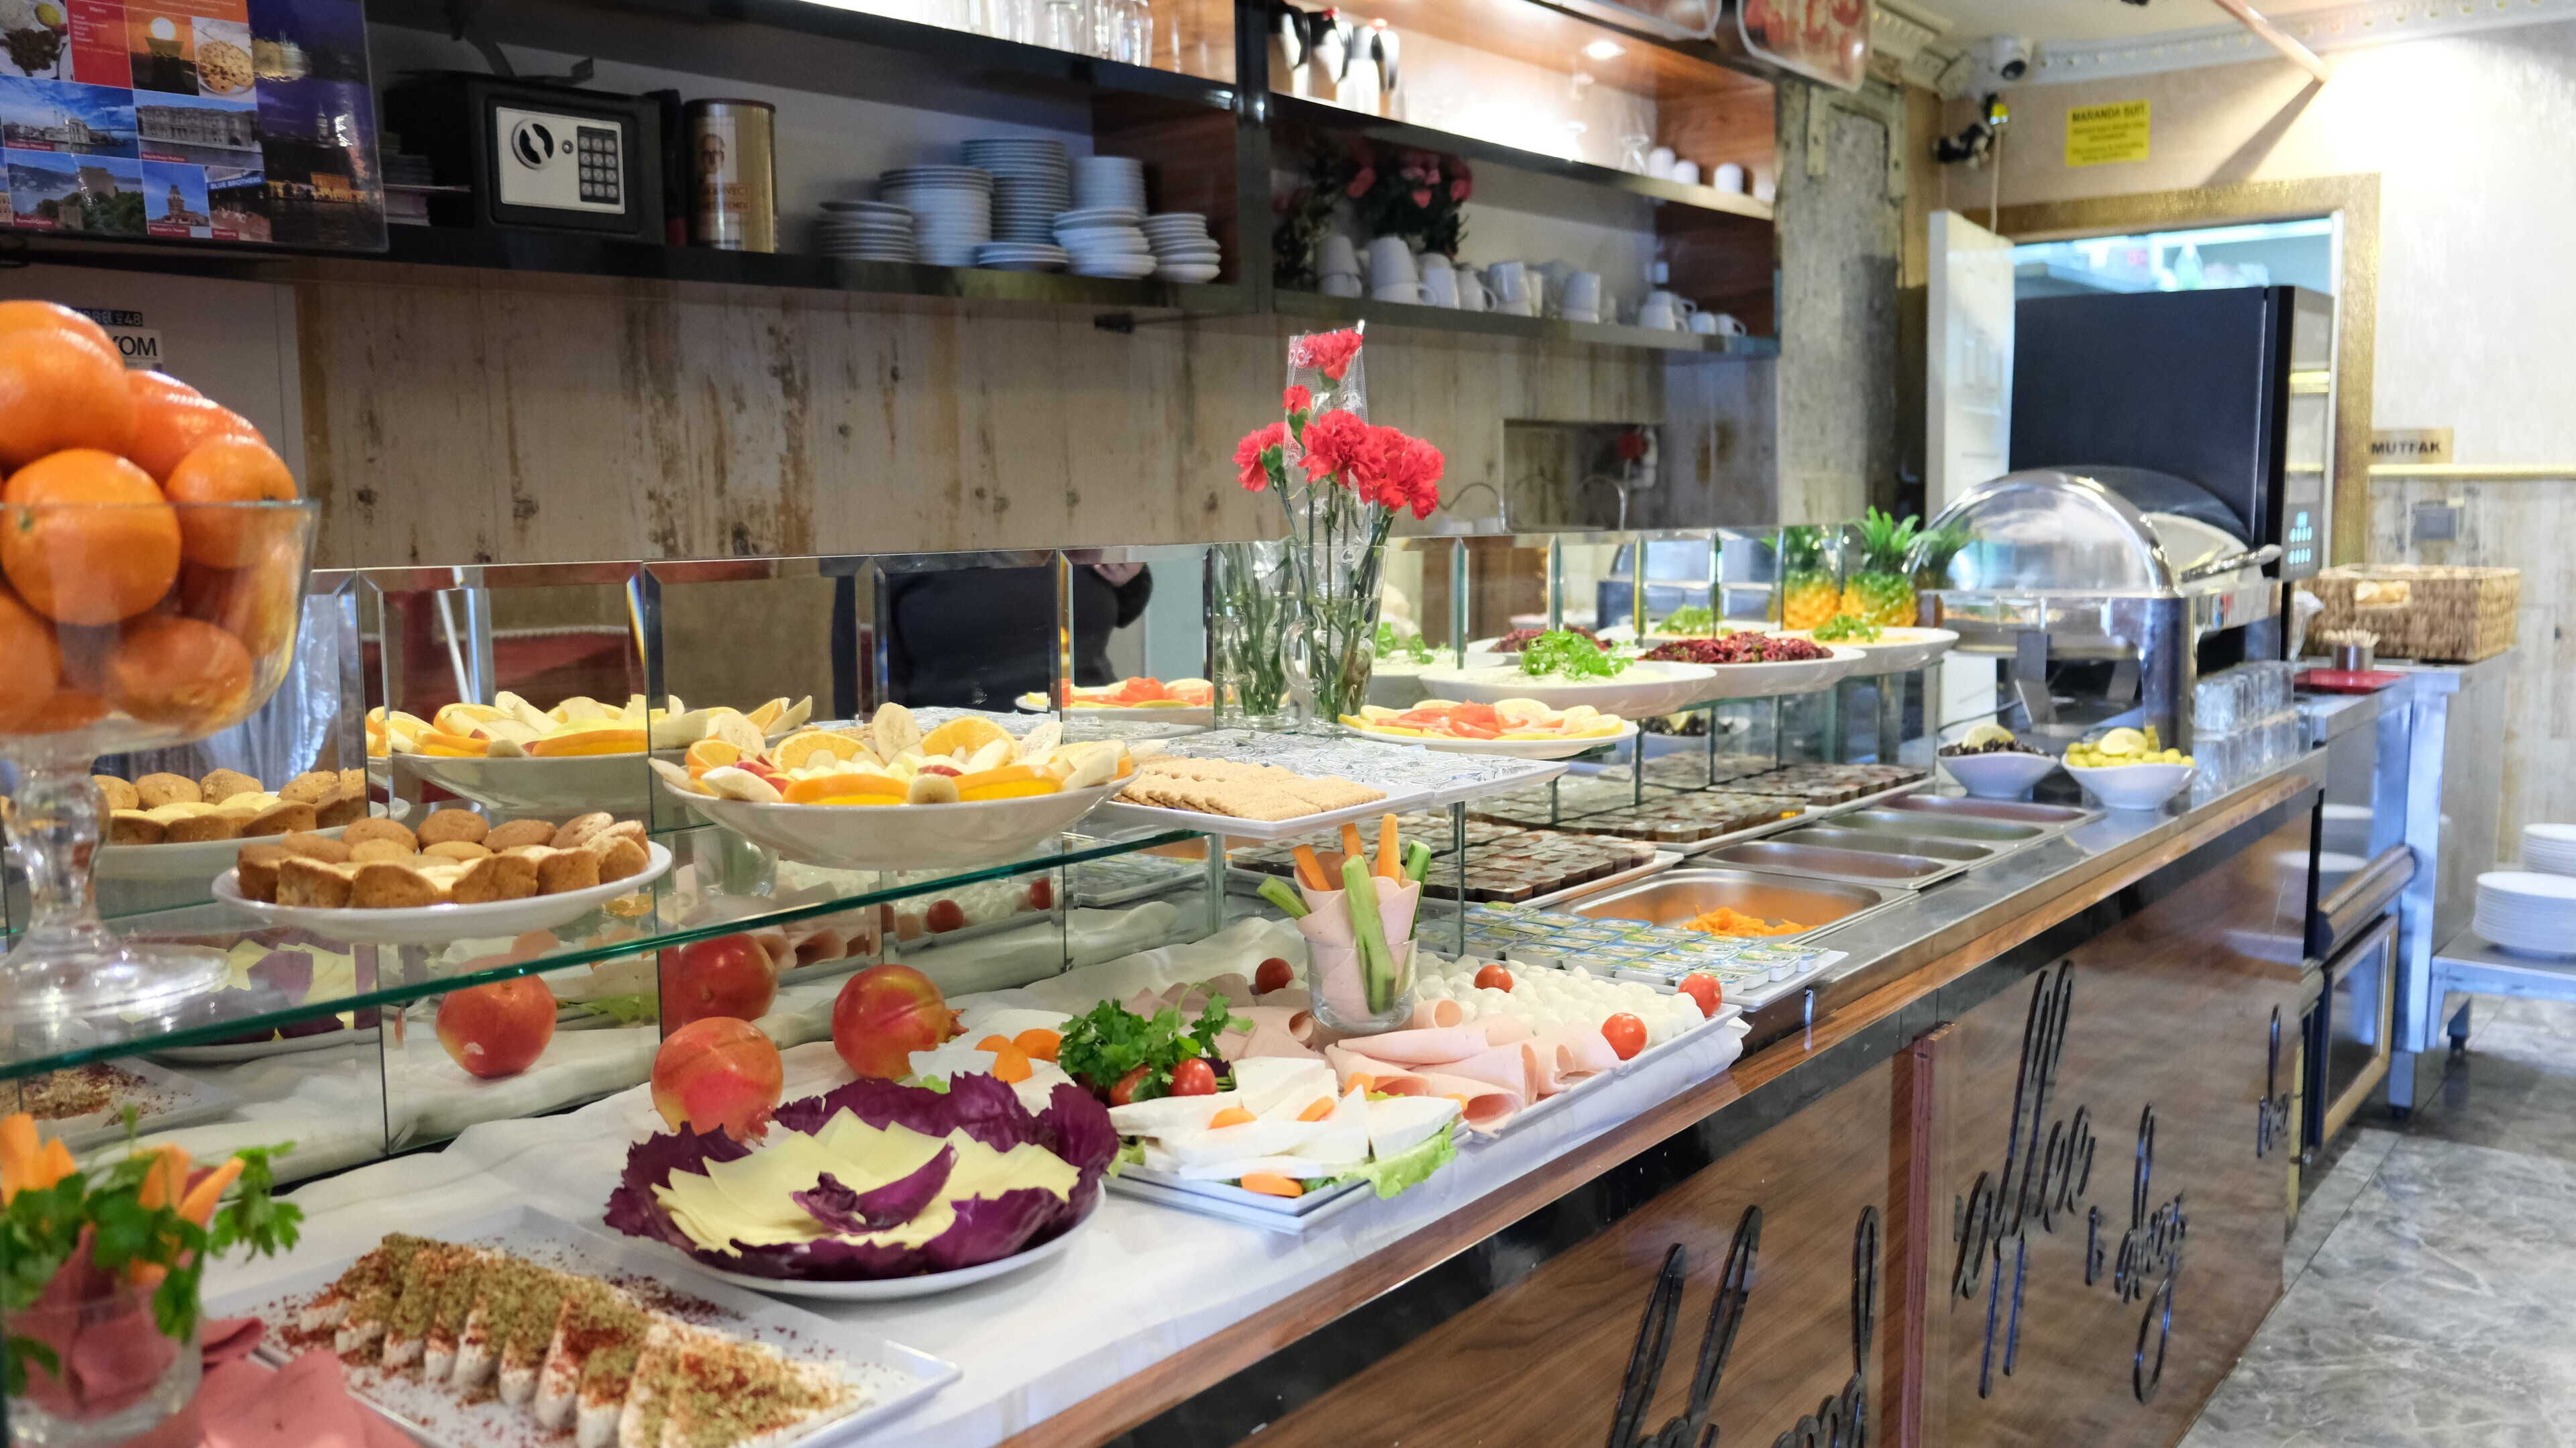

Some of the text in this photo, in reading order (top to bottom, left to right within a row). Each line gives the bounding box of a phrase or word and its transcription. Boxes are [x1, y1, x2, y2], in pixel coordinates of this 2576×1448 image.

[210, 176, 262, 190] BLUE BROTHERS
[125, 312, 141, 326] 48
[2372, 441, 2440, 455] MUTFAK
